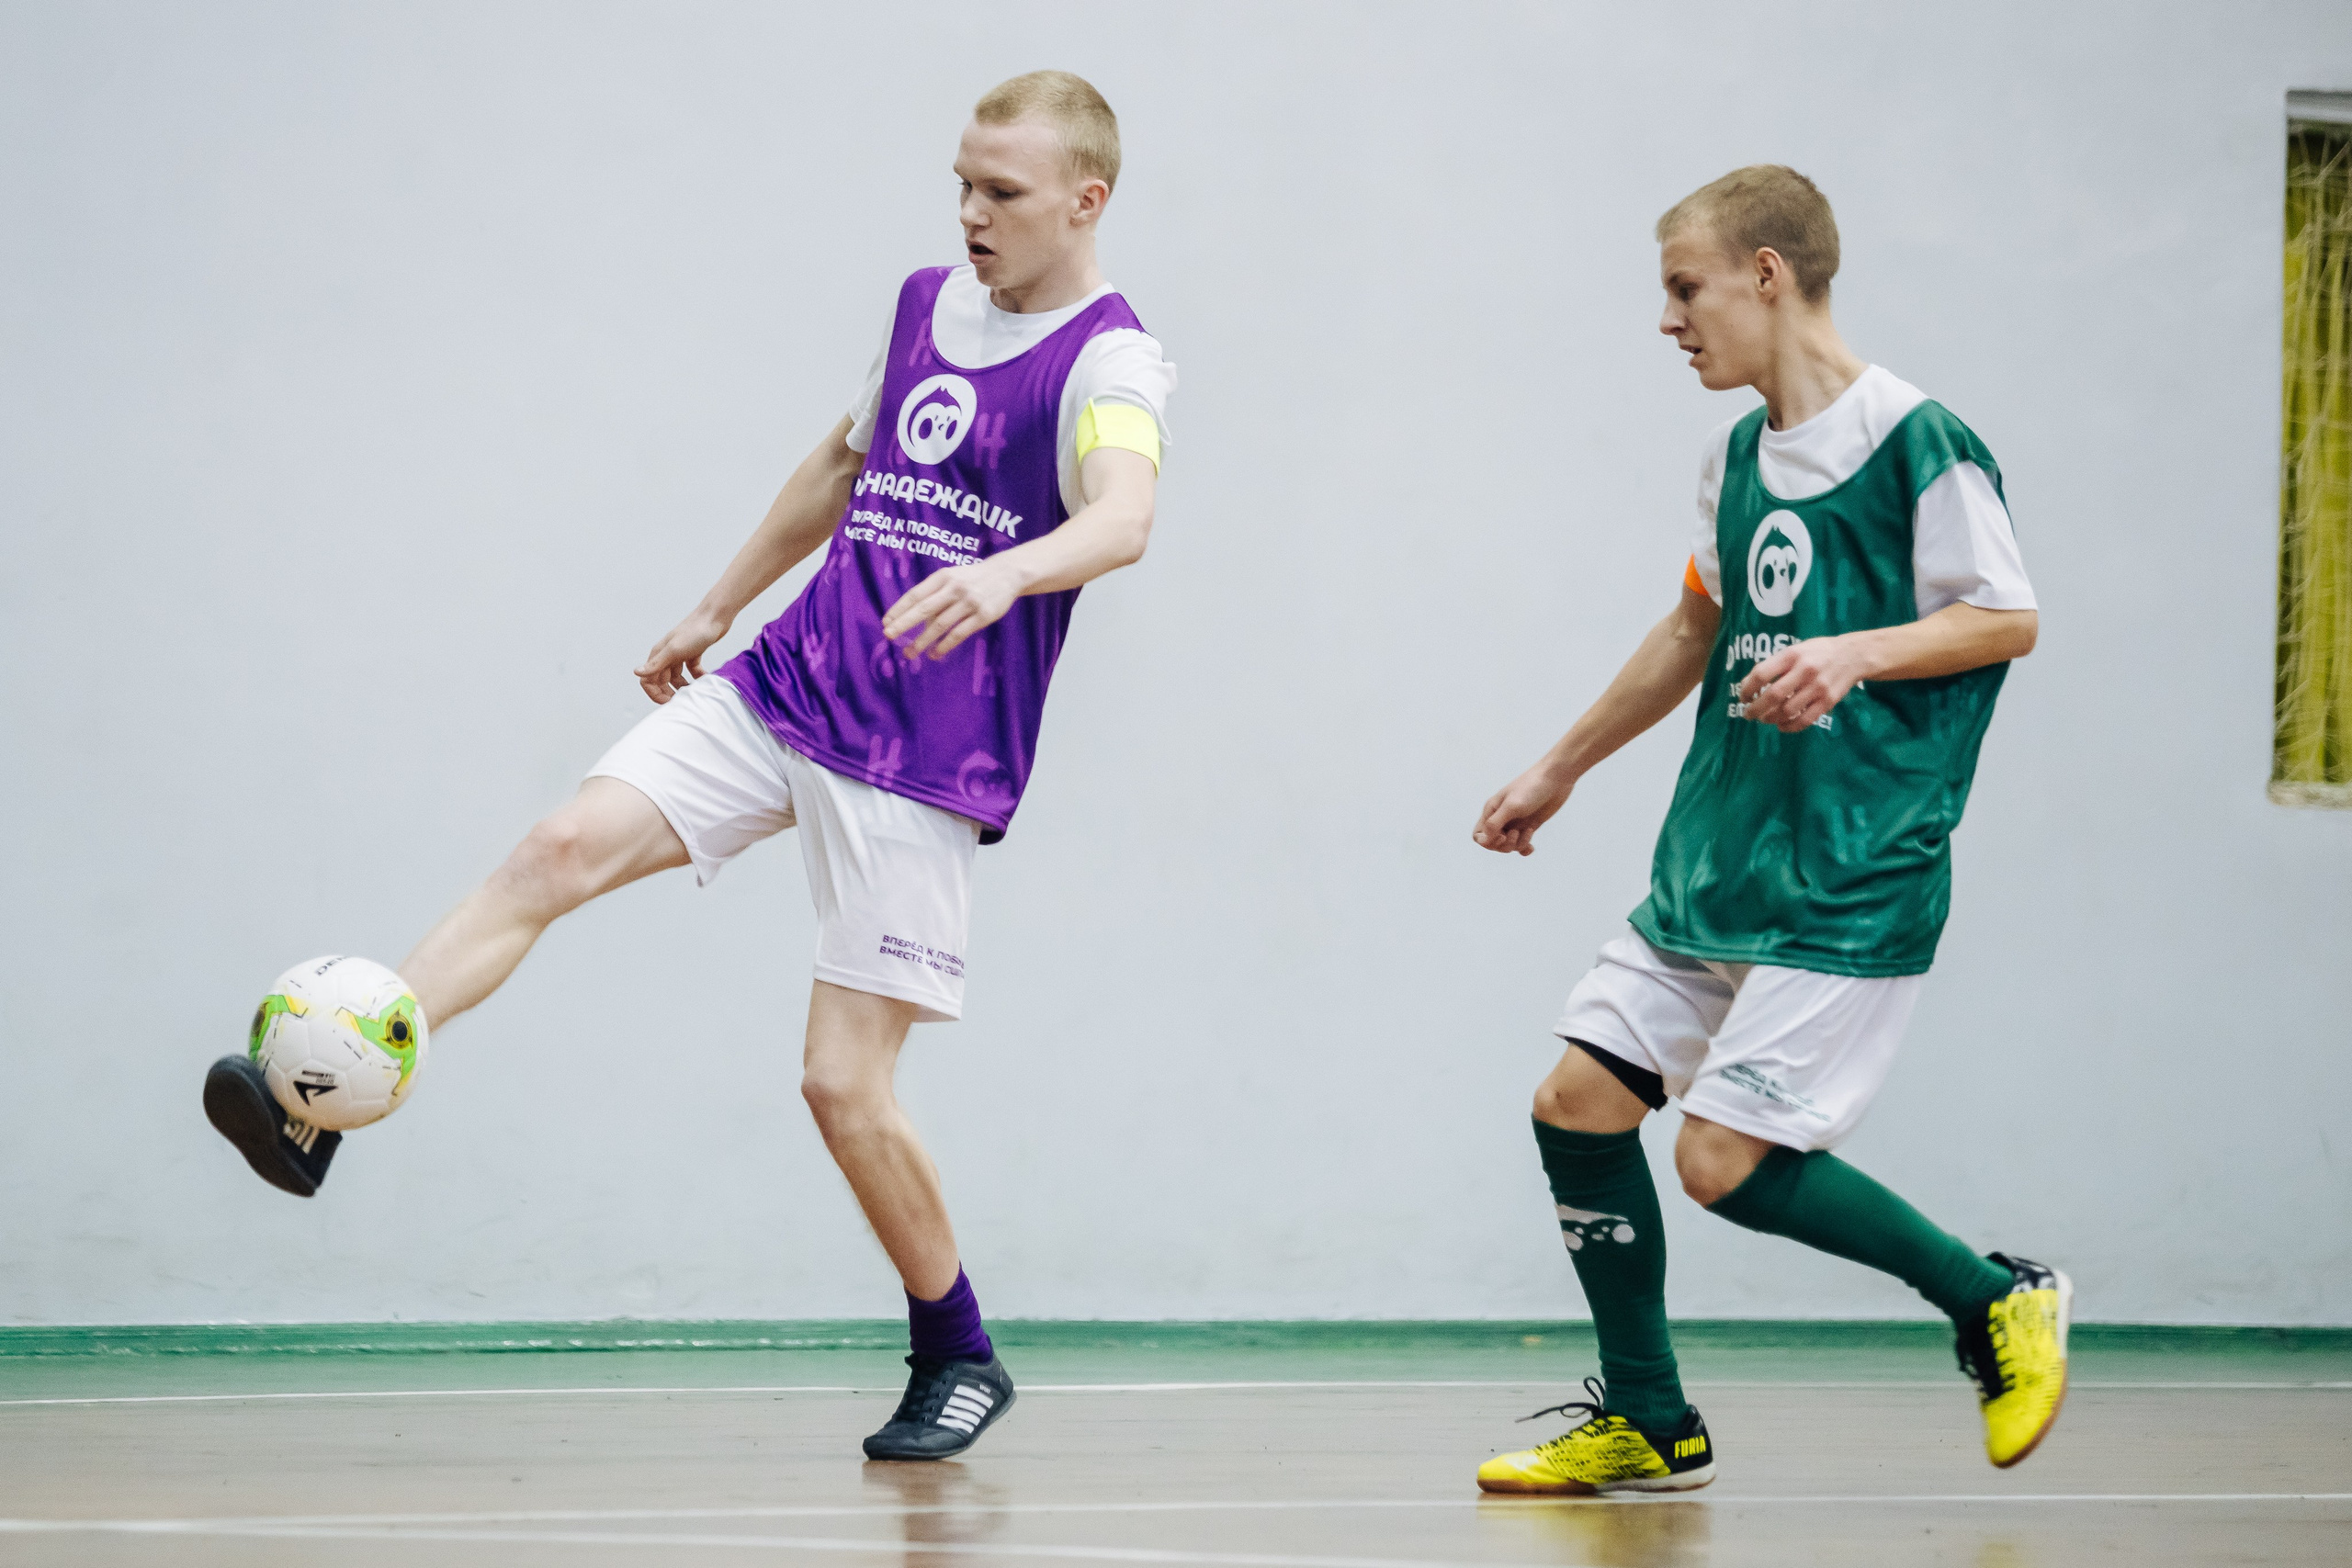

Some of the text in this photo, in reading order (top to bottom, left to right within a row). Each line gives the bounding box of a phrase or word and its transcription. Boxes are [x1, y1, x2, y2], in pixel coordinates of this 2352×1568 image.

[894, 518, 906, 533] К
[906, 520, 980, 551] ПОБЕДЕ!
[879, 945, 923, 964] ВМЕСТЕ
[882, 934, 924, 954] ВПЕРЁД
[926, 947, 934, 957] К
[1674, 1435, 1706, 1460] FURIA
